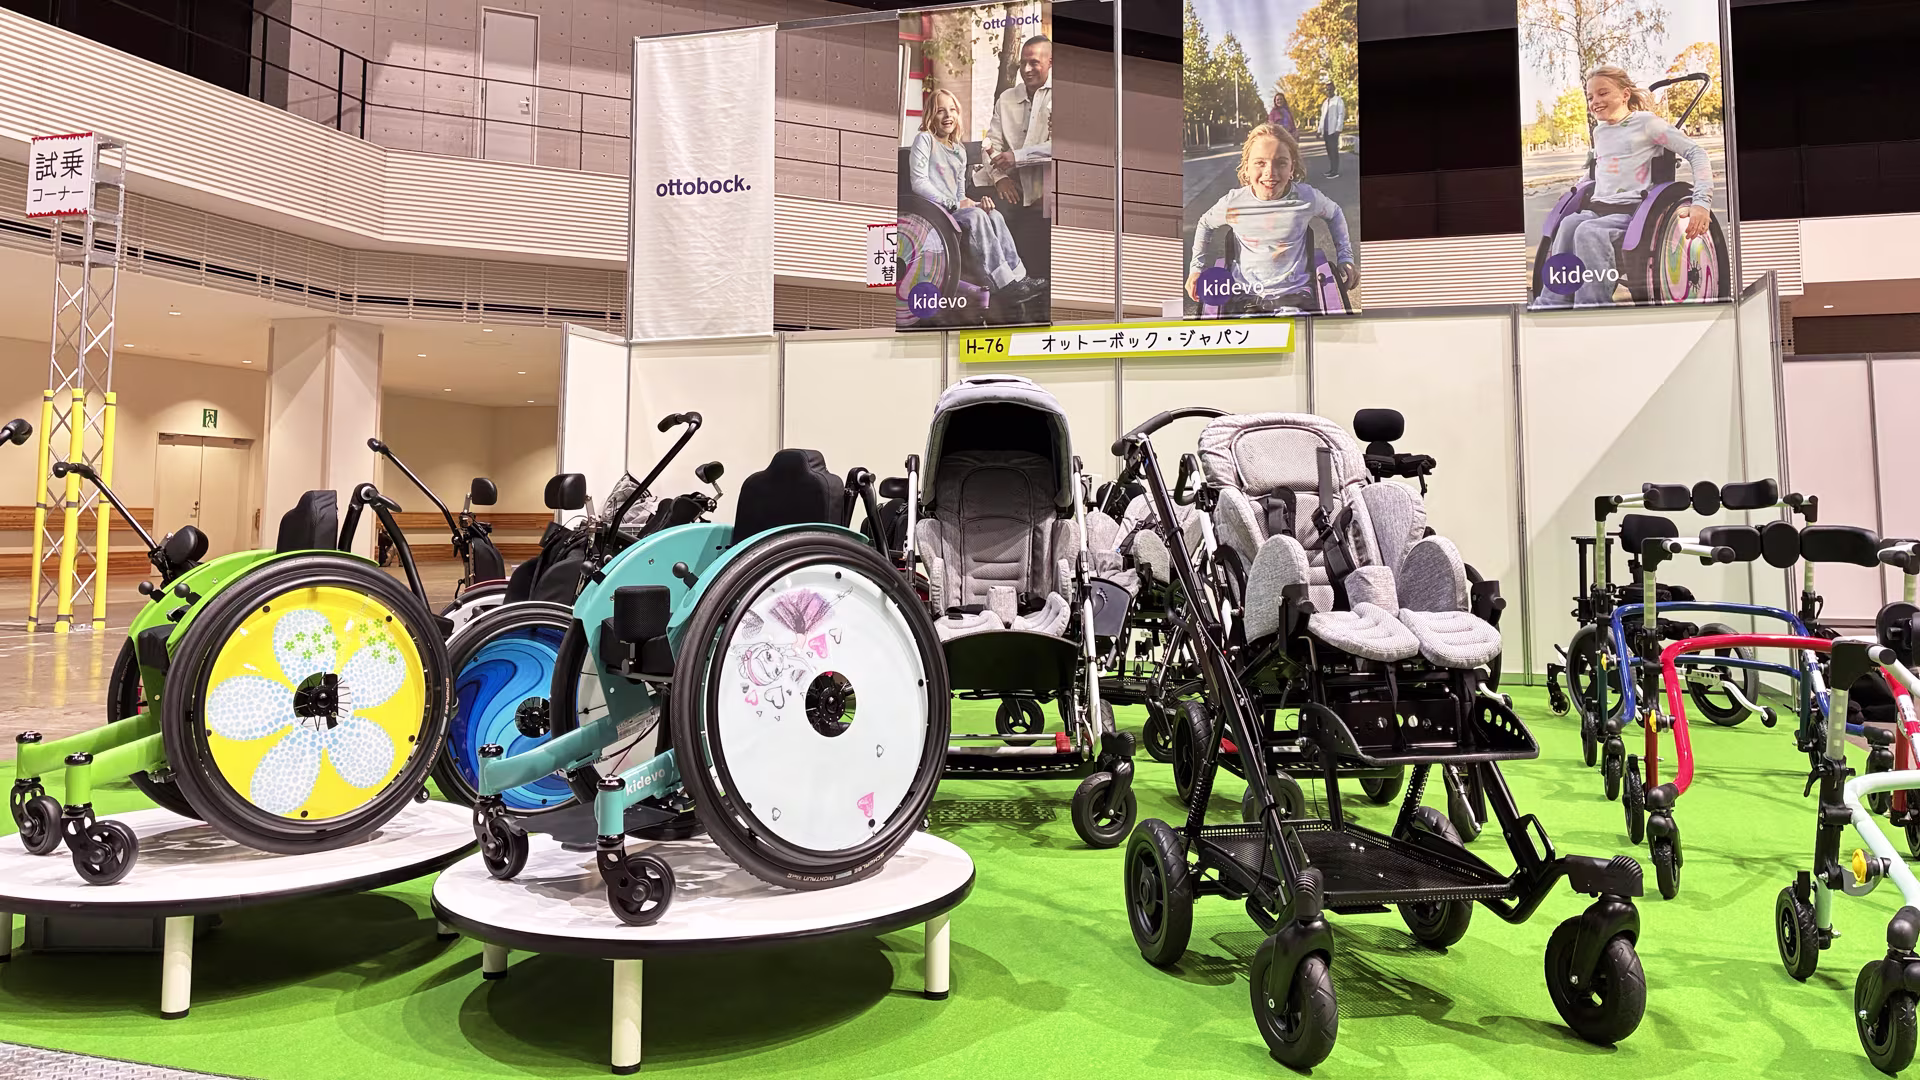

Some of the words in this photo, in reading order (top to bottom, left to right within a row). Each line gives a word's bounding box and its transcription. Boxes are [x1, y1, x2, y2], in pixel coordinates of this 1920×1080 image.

[983, 13, 1043, 30] ottobock.
[35, 147, 84, 181] 試乗
[32, 185, 84, 202] コーナー
[656, 174, 751, 197] ottobock.
[881, 265, 895, 281] 替
[1549, 265, 1619, 285] kidevo
[1203, 278, 1264, 296] kidevo
[913, 293, 967, 309] kidevo
[966, 337, 1004, 354] H-76
[1041, 328, 1250, 353] オットーボック・ジャパン
[625, 768, 666, 797] kidevo
